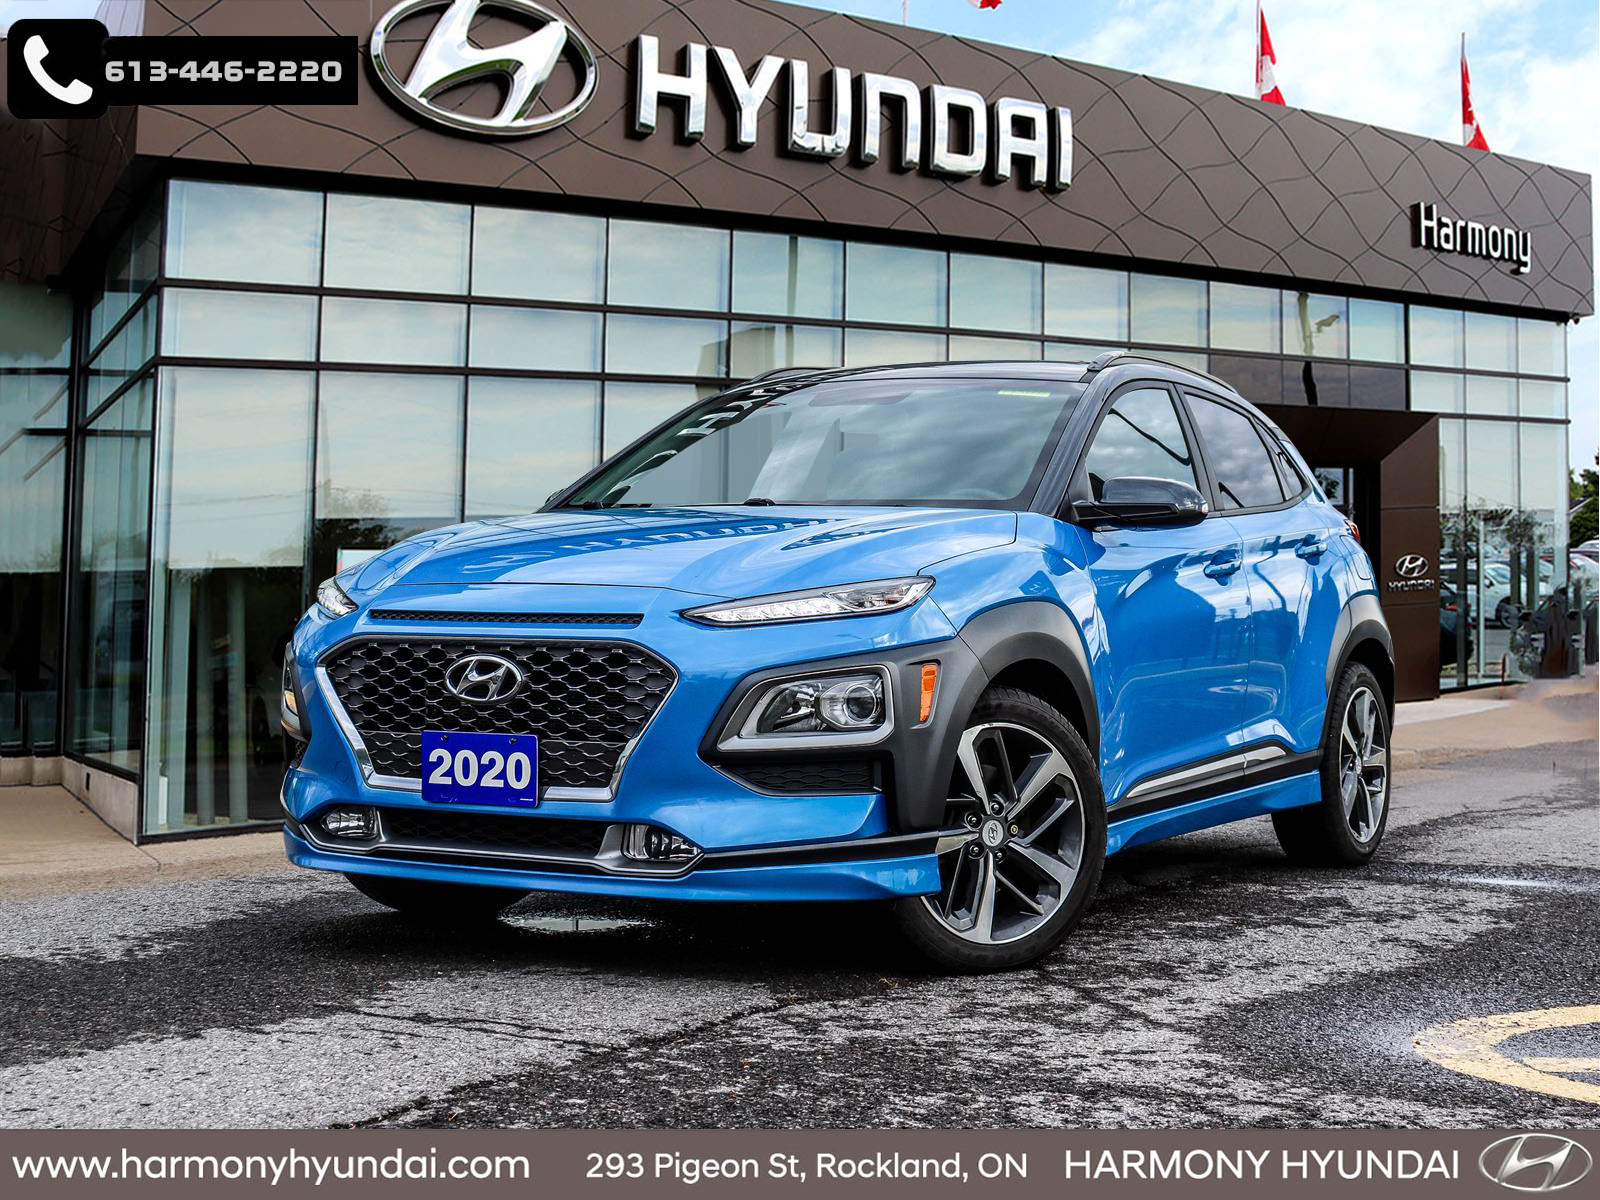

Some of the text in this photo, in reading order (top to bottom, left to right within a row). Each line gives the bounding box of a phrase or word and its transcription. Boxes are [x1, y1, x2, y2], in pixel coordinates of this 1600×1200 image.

[634, 34, 1074, 191] HYUNDAI
[1417, 201, 1532, 274] Harmony
[428, 748, 531, 790] 2020
